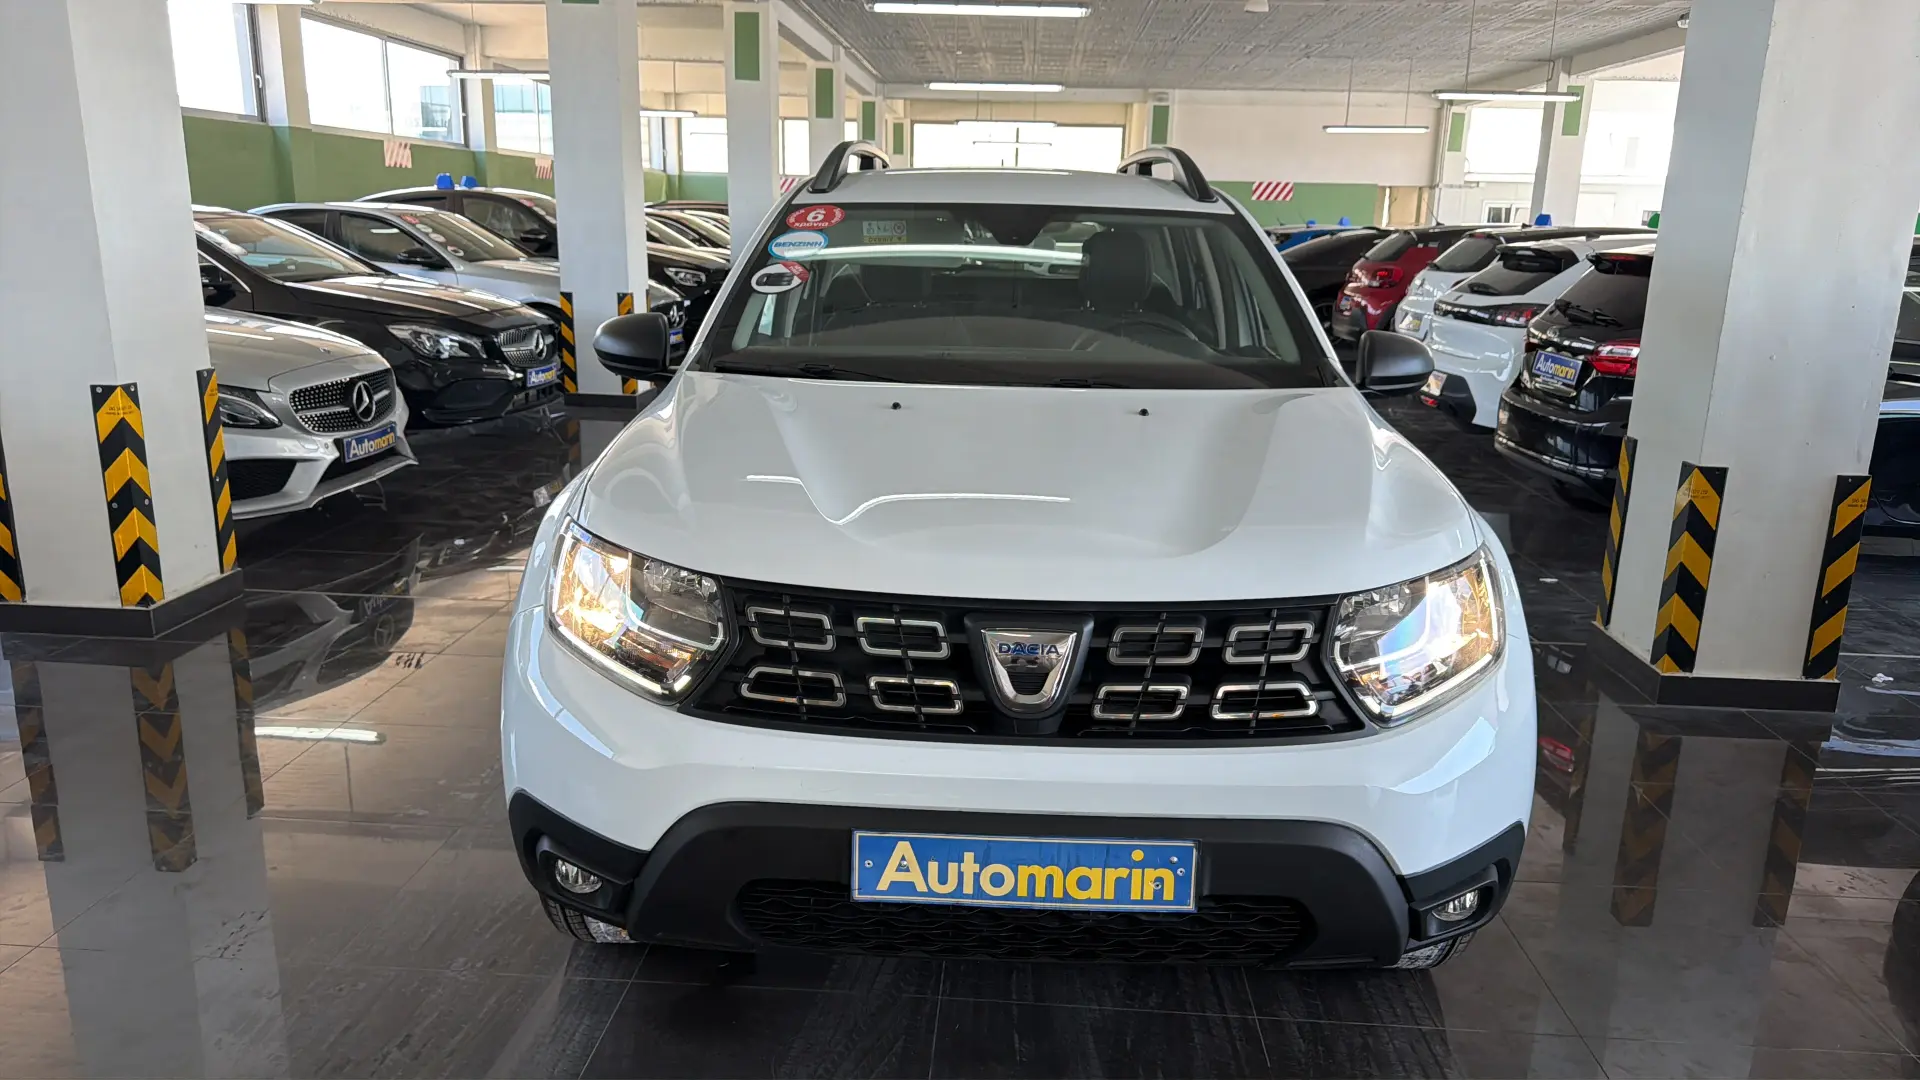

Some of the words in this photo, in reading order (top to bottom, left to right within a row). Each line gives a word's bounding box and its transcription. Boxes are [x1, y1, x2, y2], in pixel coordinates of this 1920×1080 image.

[807, 210, 826, 222] 6
[1536, 354, 1575, 380] Automarin
[350, 432, 396, 458] Automarin
[998, 642, 1060, 656] DACIA
[876, 840, 1175, 901] Automarin
